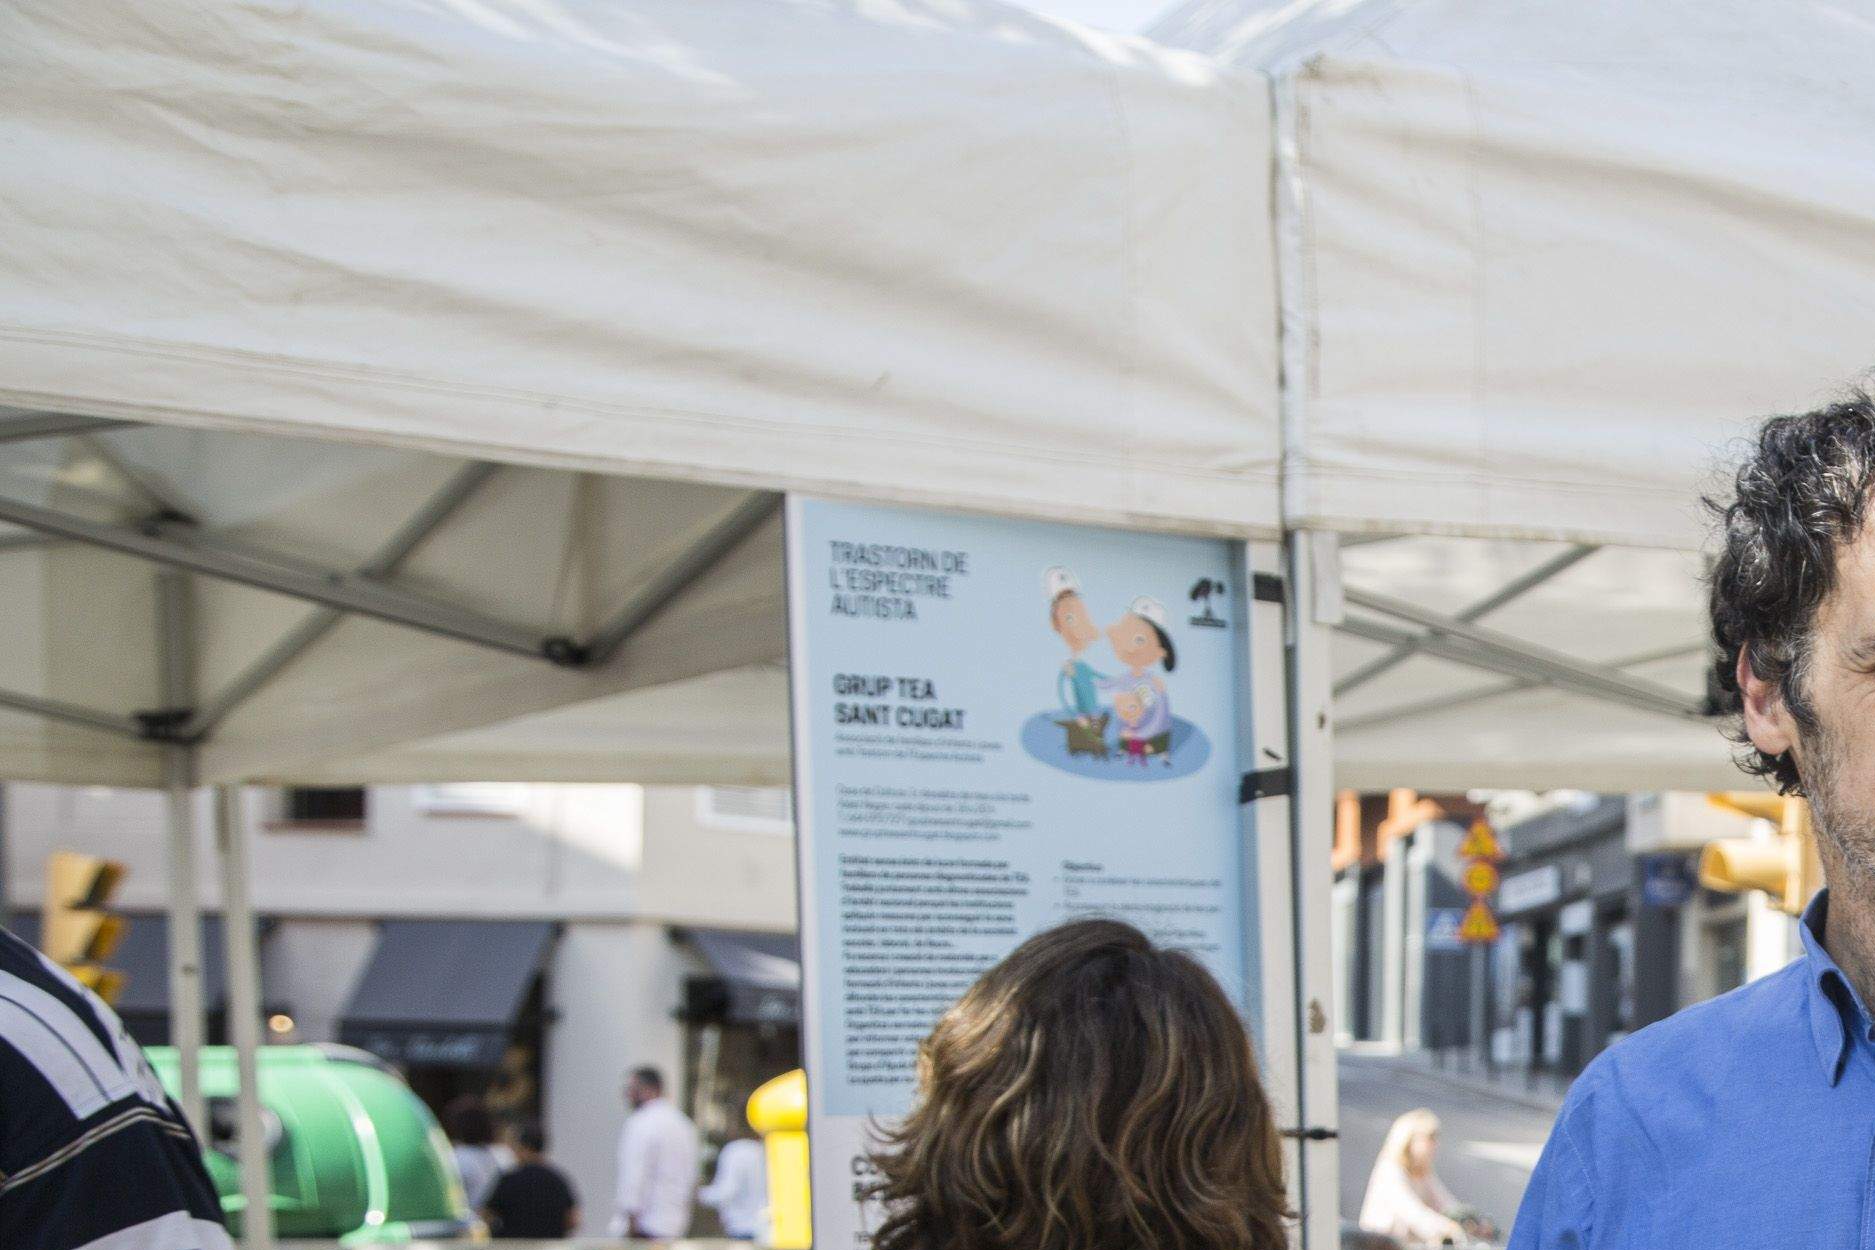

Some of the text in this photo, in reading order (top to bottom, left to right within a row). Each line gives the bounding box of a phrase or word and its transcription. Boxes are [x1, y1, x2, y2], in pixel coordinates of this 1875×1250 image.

[829, 540, 970, 575] TRASTORN DE
[830, 593, 918, 620] AUTISTA
[833, 672, 938, 700] GRUP TEA
[834, 702, 966, 730] SANT CUGAT
